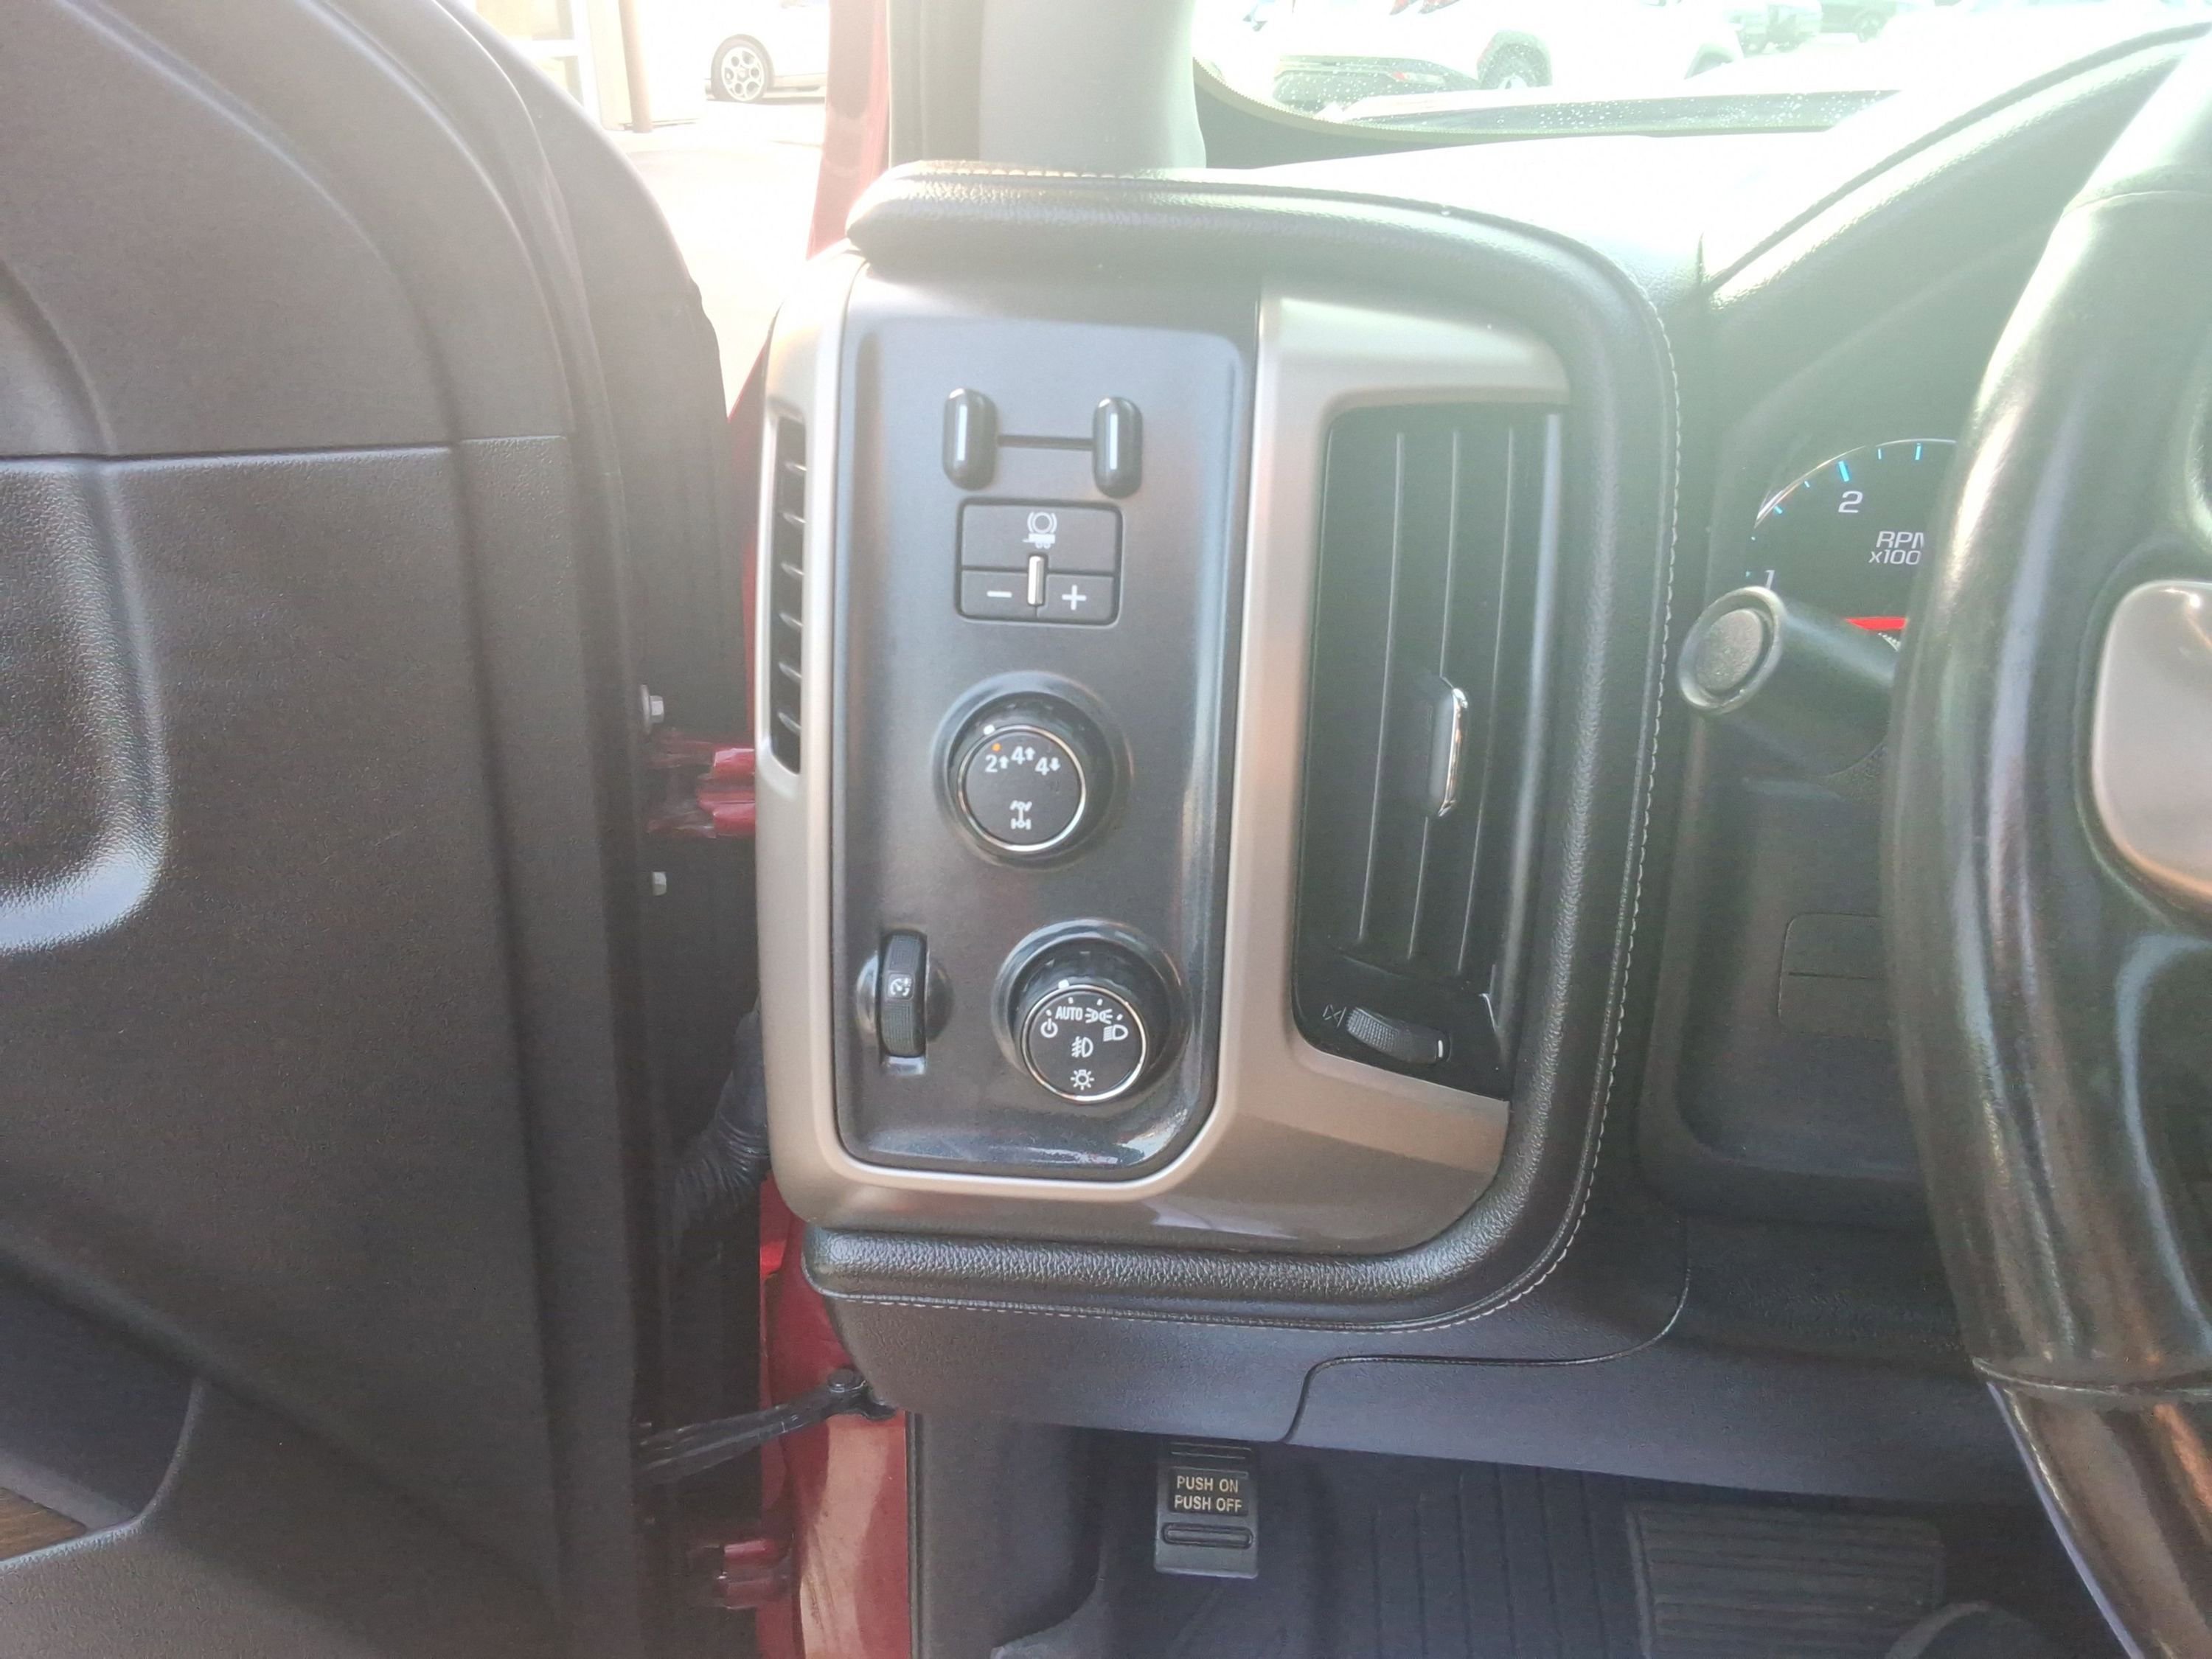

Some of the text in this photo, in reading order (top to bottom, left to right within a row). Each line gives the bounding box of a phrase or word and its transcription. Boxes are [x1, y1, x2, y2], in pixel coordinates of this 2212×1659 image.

[1837, 490, 1863, 514] 2
[1055, 1006, 1083, 1020] AUTO
[1177, 1475, 1239, 1492] PUSH ON
[1174, 1495, 1242, 1513] PUSH OFF
